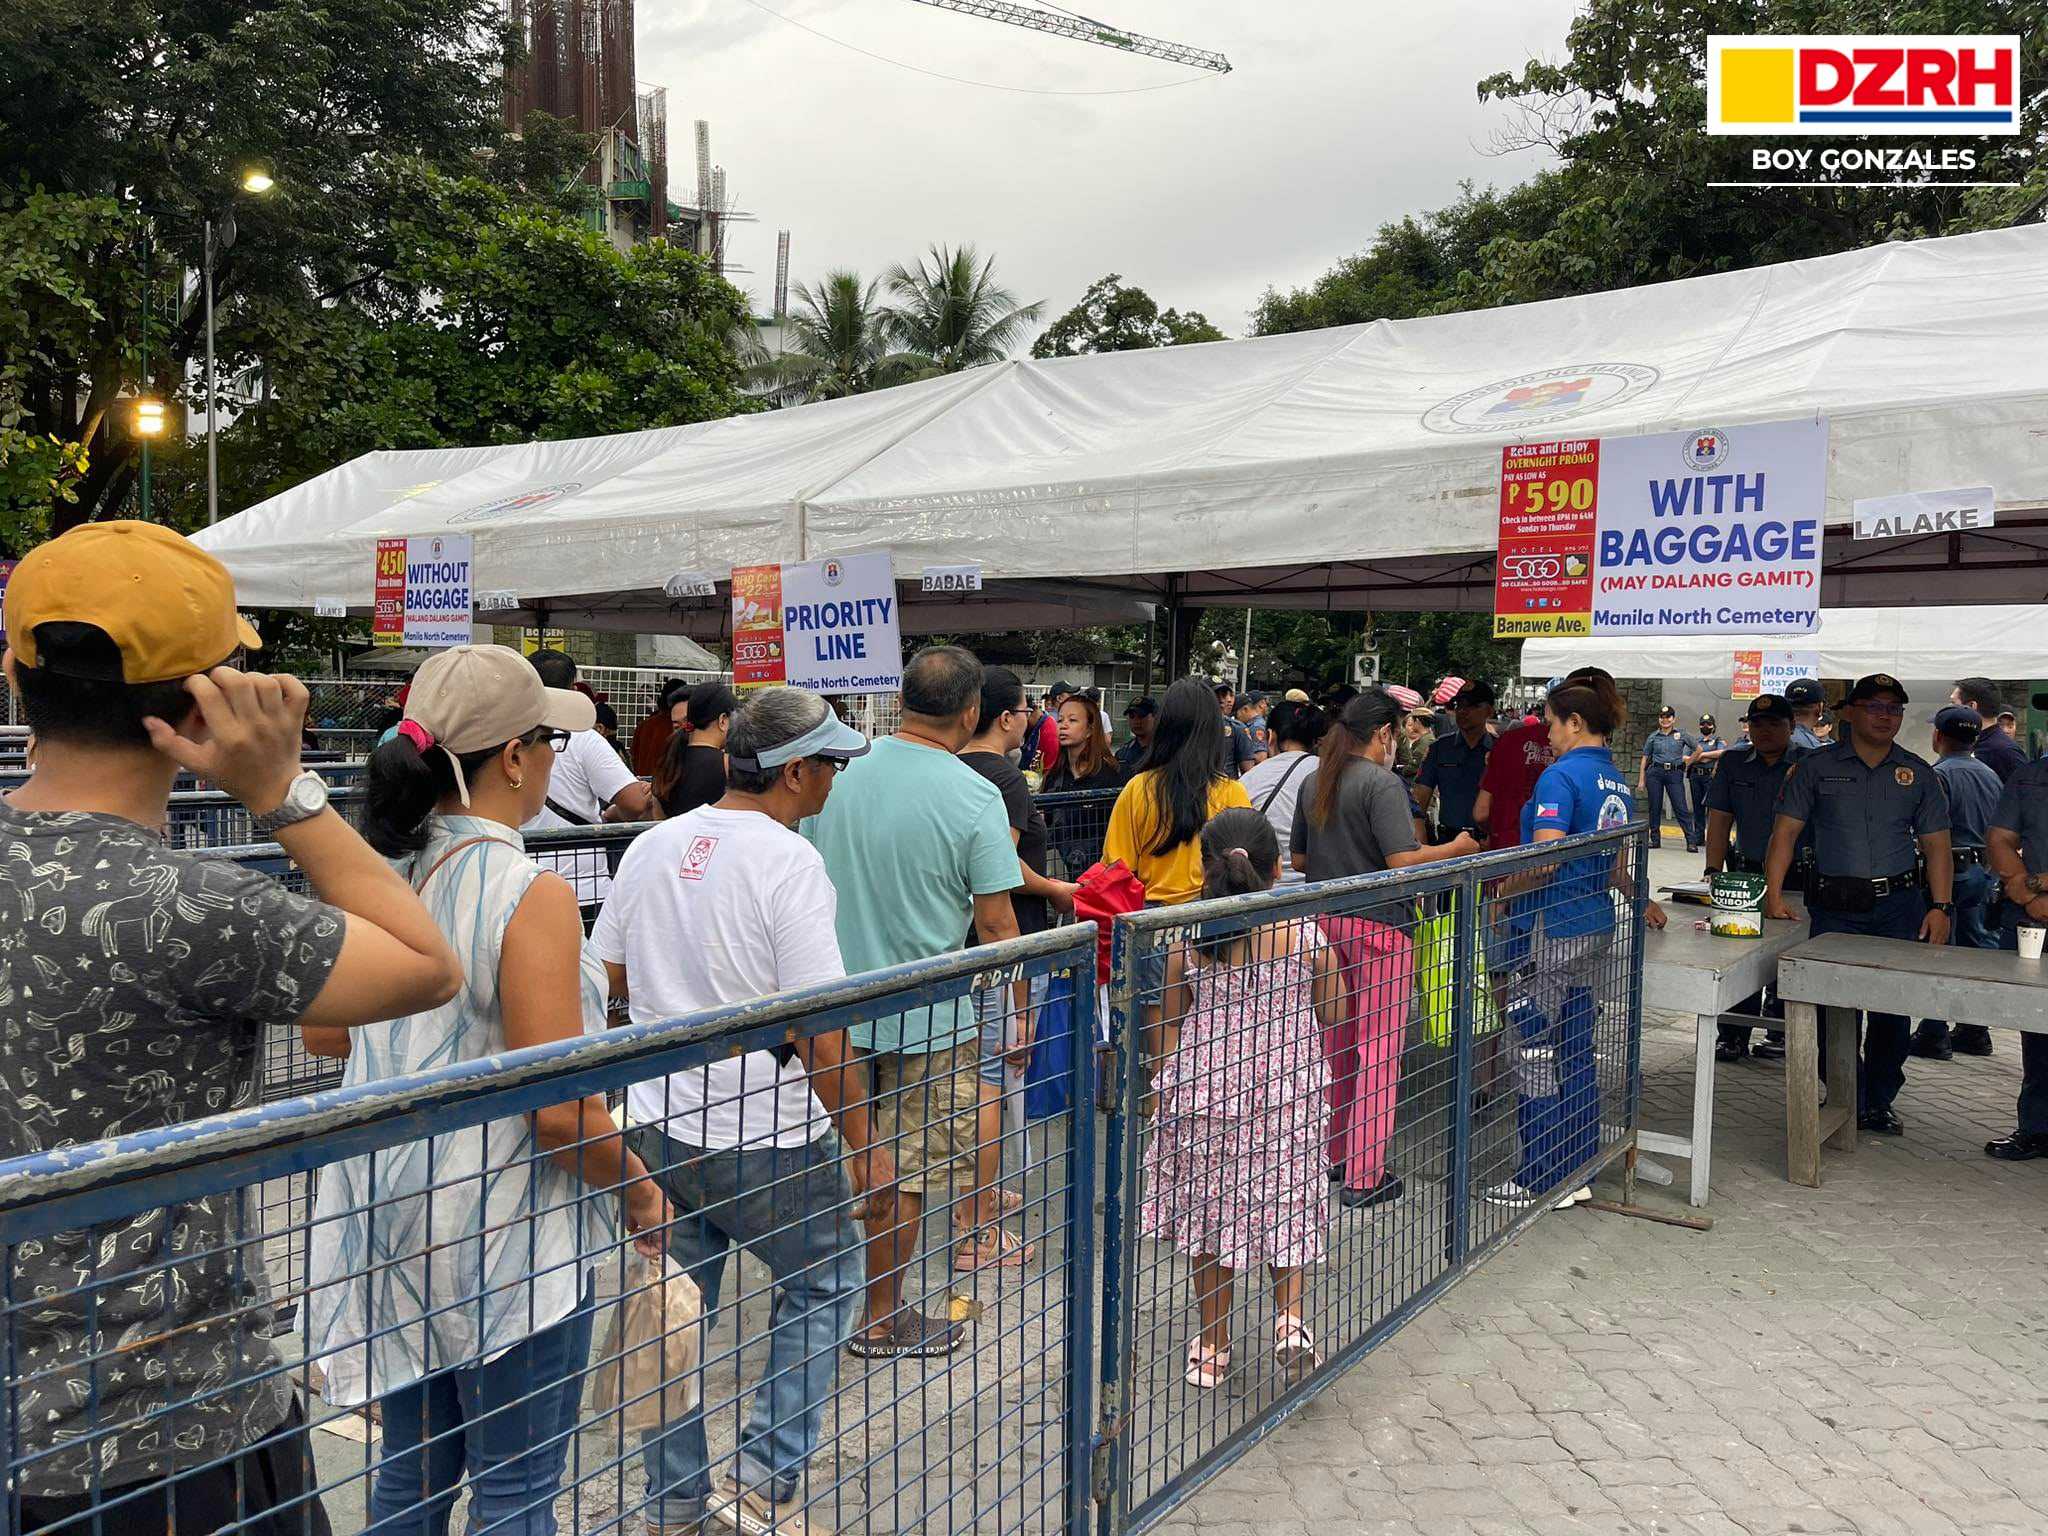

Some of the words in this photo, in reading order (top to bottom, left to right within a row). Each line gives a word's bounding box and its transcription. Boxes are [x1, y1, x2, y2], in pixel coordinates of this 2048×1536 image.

[1510, 446, 1537, 457] Relax
[1539, 443, 1558, 455] and
[1561, 441, 1589, 454] Enjoy
[1506, 456, 1557, 469] OVERNIGHT
[1559, 452, 1595, 465] PROMO
[1503, 473, 1514, 481] PAY
[1515, 472, 1523, 481] AS
[1524, 472, 1537, 480] LOW
[1538, 471, 1547, 480] AS
[1524, 478, 1594, 513] 590
[1649, 472, 1765, 518] WITH
[1502, 515, 1521, 524] Check
[1522, 515, 1528, 523] in
[1529, 514, 1556, 523] between
[1571, 512, 1578, 520] to
[1854, 508, 1979, 539] LALAKE
[1517, 524, 1539, 534] Sunday
[1548, 523, 1577, 532] Thursday
[1599, 519, 1817, 568] BAGGAGE
[407, 561, 469, 584] WITHOUT
[1503, 553, 1561, 579] SOGO
[666, 583, 709, 597] LALAKE
[923, 574, 976, 590] BABAE
[1600, 575, 1648, 594] (MAY
[1652, 571, 1733, 589] DALANG
[1737, 570, 1815, 588] GAMIT)
[406, 588, 469, 610] BAGGAGE
[479, 596, 514, 609] BABAE
[430, 614, 450, 623] DALANG
[784, 597, 893, 632] PRIORITY
[1593, 608, 1654, 626] Manila
[1658, 607, 1712, 625] North
[1716, 606, 1816, 628] Cemetery
[1496, 616, 1551, 634] Banawe
[404, 631, 423, 641] Manila
[423, 631, 440, 641] North
[441, 631, 470, 643] Cemetery
[815, 633, 867, 662] LINE
[1763, 666, 1809, 676] MDSW
[821, 676, 849, 688] North
[850, 674, 900, 688] Cemetery
[1761, 679, 1789, 687] LOST
